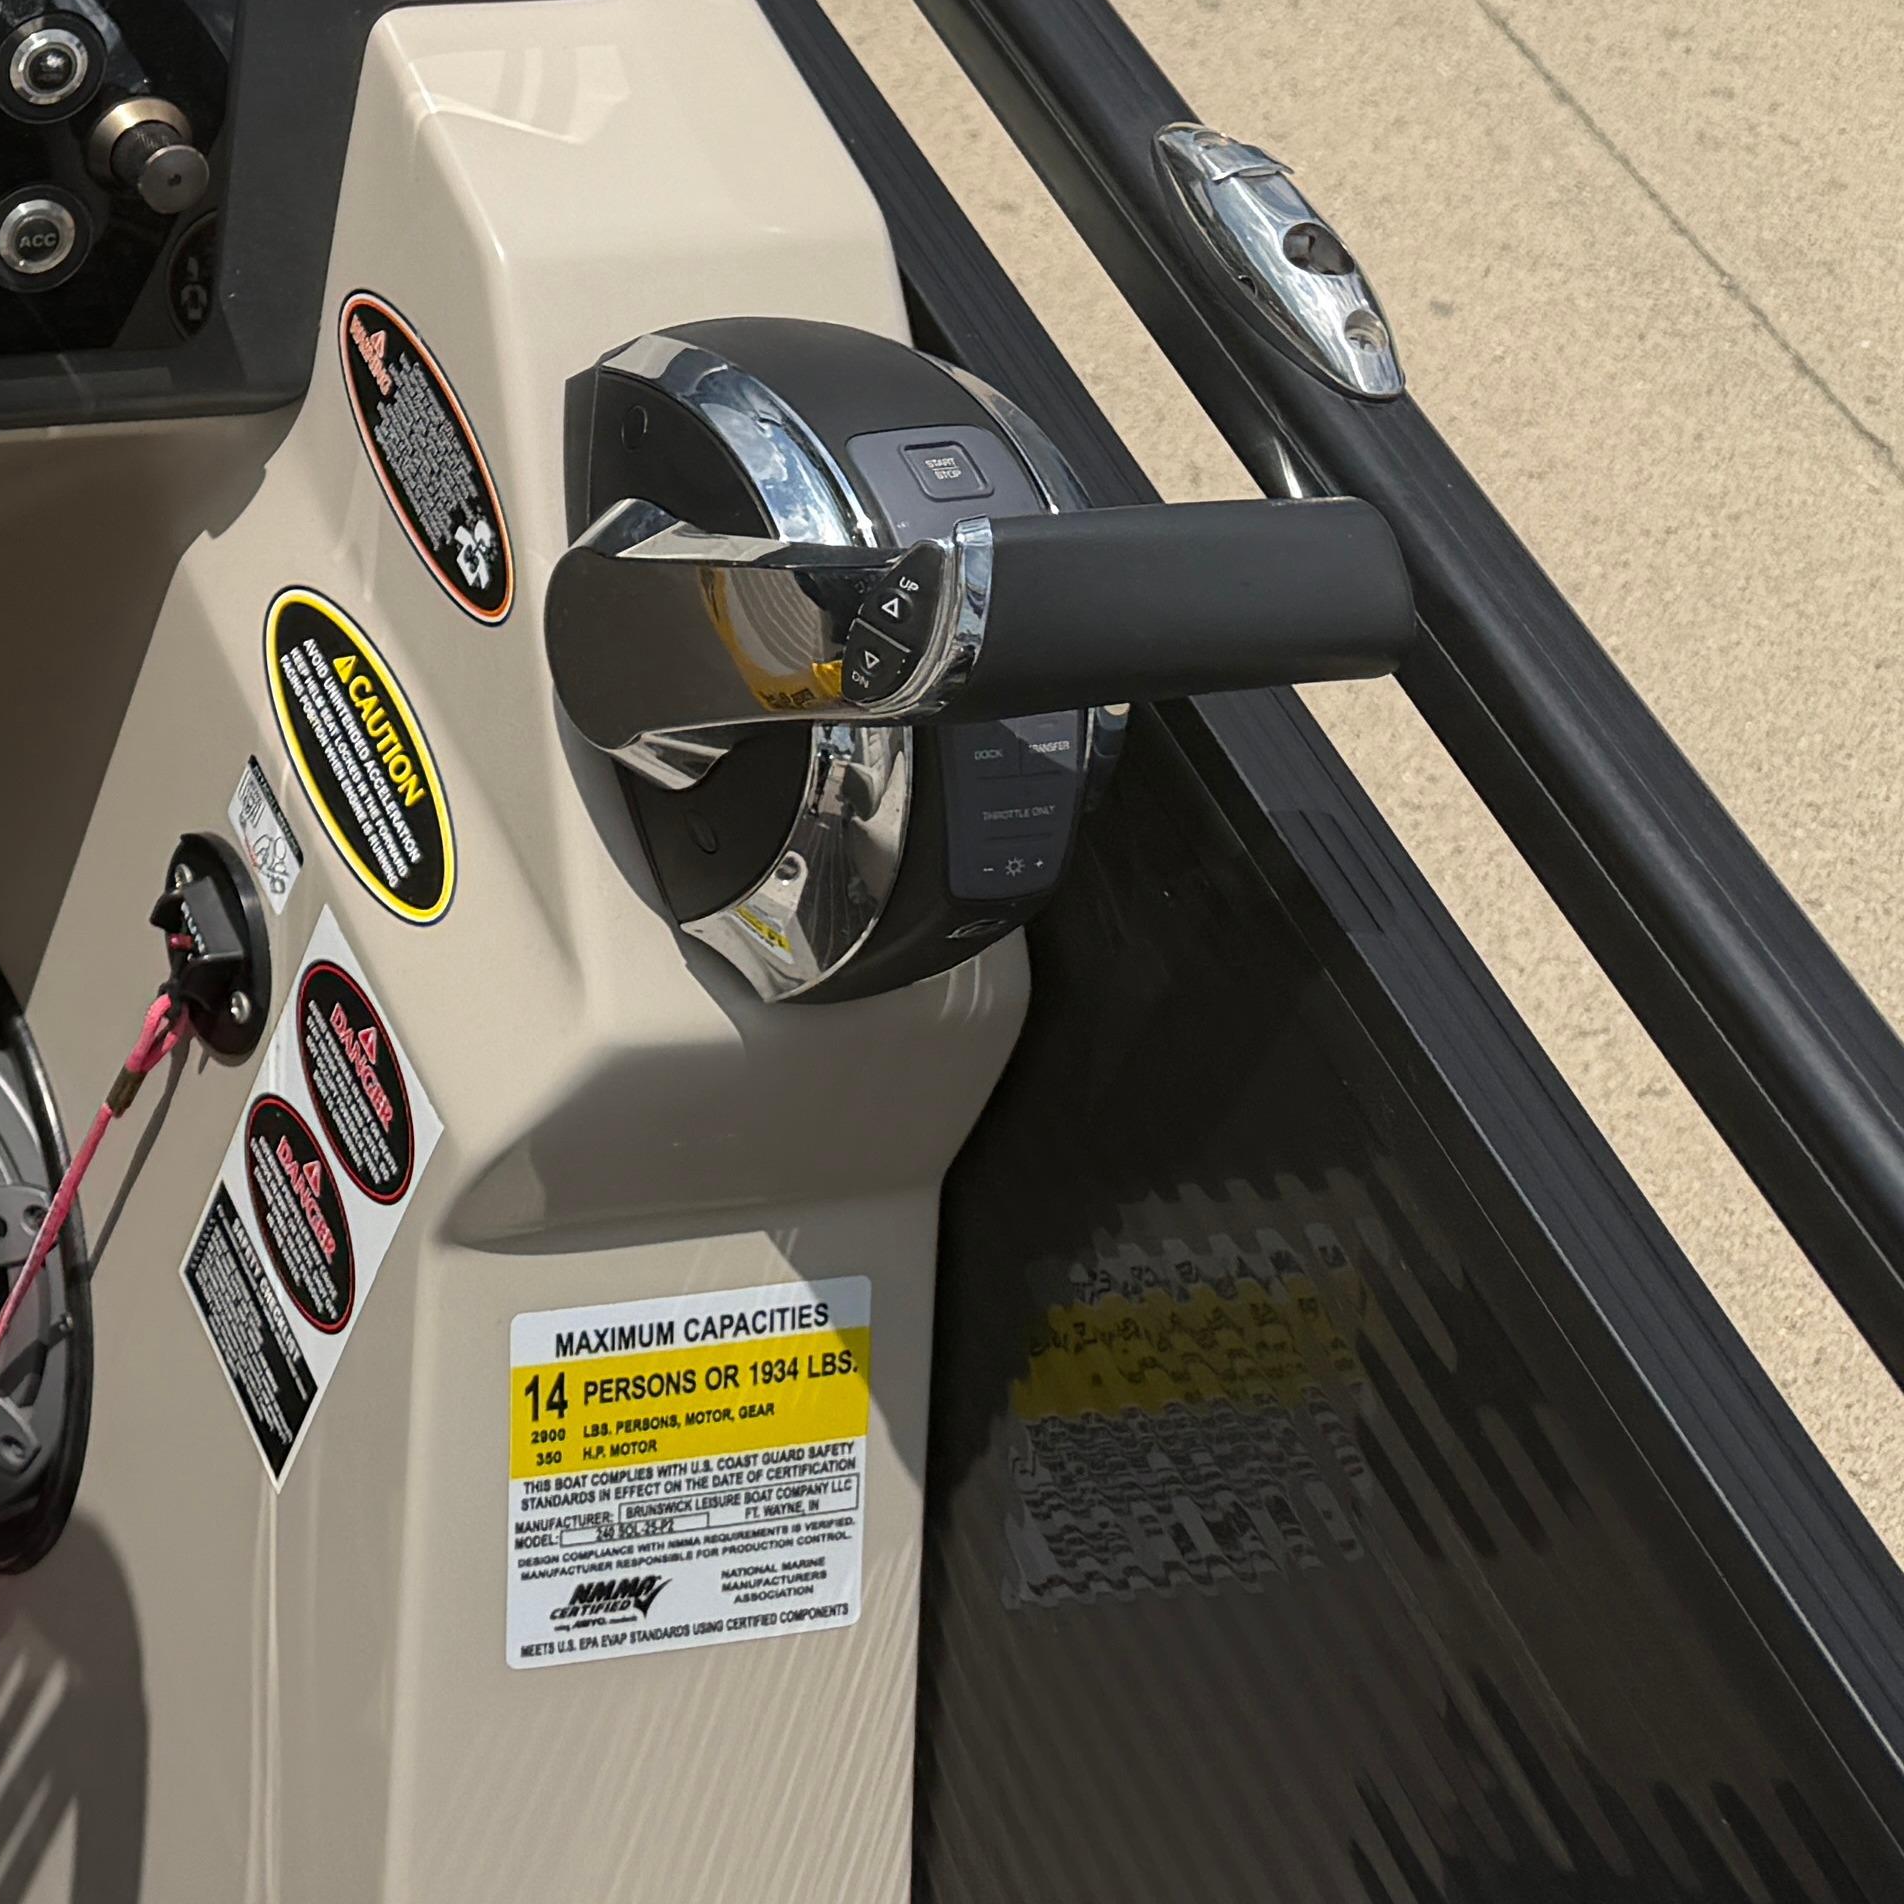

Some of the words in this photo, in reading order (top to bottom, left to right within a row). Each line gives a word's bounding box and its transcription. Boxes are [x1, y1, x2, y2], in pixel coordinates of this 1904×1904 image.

[19, 232, 57, 249] ACC
[925, 457, 956, 469] START
[934, 470, 962, 481] STOP
[899, 576, 920, 593] UP
[851, 670, 870, 689] DN
[302, 636, 330, 679] AVOID
[321, 675, 371, 761] UNINTENDED
[362, 758, 421, 863] ACCELERATION
[348, 674, 426, 808] CAUTION
[974, 749, 1004, 761] DOCK
[322, 743, 347, 781] WHEN
[332, 735, 362, 783] LOCKED
[355, 781, 369, 797] IN
[362, 795, 381, 820] THE
[373, 818, 409, 878] FORWARD
[1032, 804, 1056, 817] ONLY
[330, 1001, 394, 1134] DANGER
[275, 1134, 336, 1265] DANGER
[231, 1215, 261, 1281] SAFETY
[555, 1321, 675, 1358] MAXIMUM
[684, 1302, 829, 1343] CAPACITIES
[524, 1371, 568, 1422] 14
[584, 1369, 697, 1406] PERSONS
[705, 1364, 740, 1391] OR
[749, 1356, 799, 1386] 1934
[807, 1349, 859, 1379] LBS.
[583, 1423, 612, 1438] LBS.
[615, 1414, 681, 1436] PERSONS,
[685, 1407, 735, 1426] MOTOR,
[738, 1402, 775, 1419] GEAR
[523, 1480, 552, 1495] THIS
[555, 1474, 588, 1492] BOAT
[590, 1466, 654, 1485] COMPLIES
[656, 1462, 688, 1479] WITH
[691, 1459, 713, 1474] U.S.
[716, 1454, 760, 1471] COAST
[761, 1448, 805, 1465] GUARD
[807, 1441, 855, 1458] SAFETY
[536, 1451, 563, 1466] 350
[583, 1445, 606, 1461] H.P.
[610, 1439, 658, 1457] MOTOR
[521, 1491, 596, 1511] STANDARDS
[598, 1488, 611, 1502] IN
[614, 1482, 661, 1501] EFFECT
[664, 1479, 682, 1493] ON
[685, 1475, 709, 1491] THE
[712, 1471, 744, 1487] DATE
[746, 1468, 764, 1484] OF
[766, 1457, 857, 1481] CERTIFICATION
[514, 1511, 614, 1535] MANUFACTURER:
[625, 1500, 692, 1519] BRUNSWICK
[695, 1492, 742, 1511] LEISURE
[743, 1489, 774, 1505] BOAT
[775, 1481, 829, 1501] COMPANY
[831, 1479, 853, 1494] LLC
[808, 1499, 820, 1512] IN
[514, 1534, 559, 1550] MODEL:
[518, 1554, 560, 1569] DESIGN
[562, 1544, 635, 1564] COMPLIANCE
[636, 1541, 665, 1553] WITH
[703, 1525, 789, 1544] REQUIREMENTS
[520, 1560, 613, 1581] MANUFACTURER
[615, 1550, 694, 1569] RESPONSIBLE
[696, 1545, 720, 1560] FOR
[721, 1537, 794, 1557] PRODUCTION
[721, 1564, 778, 1580] NATIONAL
[781, 1556, 826, 1571] MARINE
[721, 1570, 828, 1593] MANUFACTURERS
[569, 1575, 657, 1605] NMMA
[733, 1585, 815, 1605] ASSOCIATION
[549, 1599, 631, 1621] CERTIFIED
[520, 1644, 555, 1658] MEETS
[579, 1637, 599, 1650] EPA
[601, 1633, 628, 1648] EVAP
[629, 1624, 691, 1644] STANDARDS
[692, 1619, 724, 1635] USING
[726, 1612, 777, 1632] CERTIFIED
[779, 1602, 850, 1624] COMPONENTS
